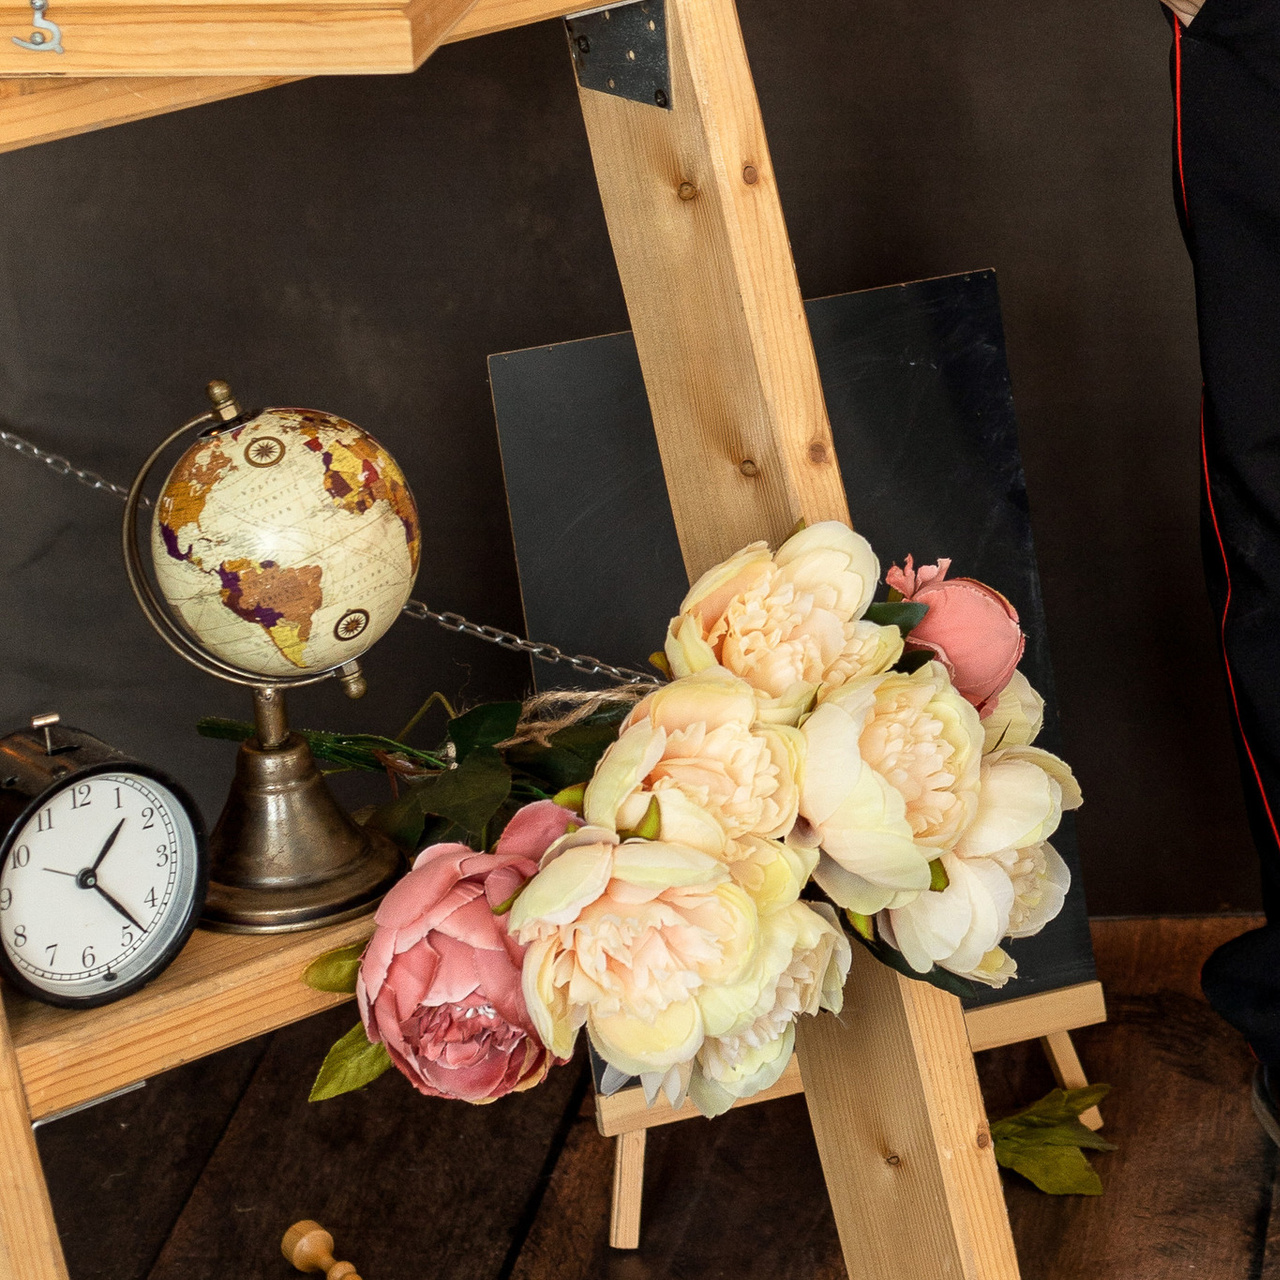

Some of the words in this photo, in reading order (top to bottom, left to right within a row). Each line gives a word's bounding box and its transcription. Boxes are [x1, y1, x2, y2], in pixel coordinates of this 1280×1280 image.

[70, 784, 92, 810] 12
[114, 787, 123, 810] 1
[36, 807, 54, 833] 11
[141, 807, 155, 830] 2
[10, 844, 30, 870] 10
[156, 844, 169, 867] 3
[0, 888, 12, 911] 9
[144, 886, 159, 909] 4
[13, 925, 28, 947] 8
[120, 924, 134, 947] 5
[45, 943, 58, 967] 7
[82, 946, 96, 968] 6
